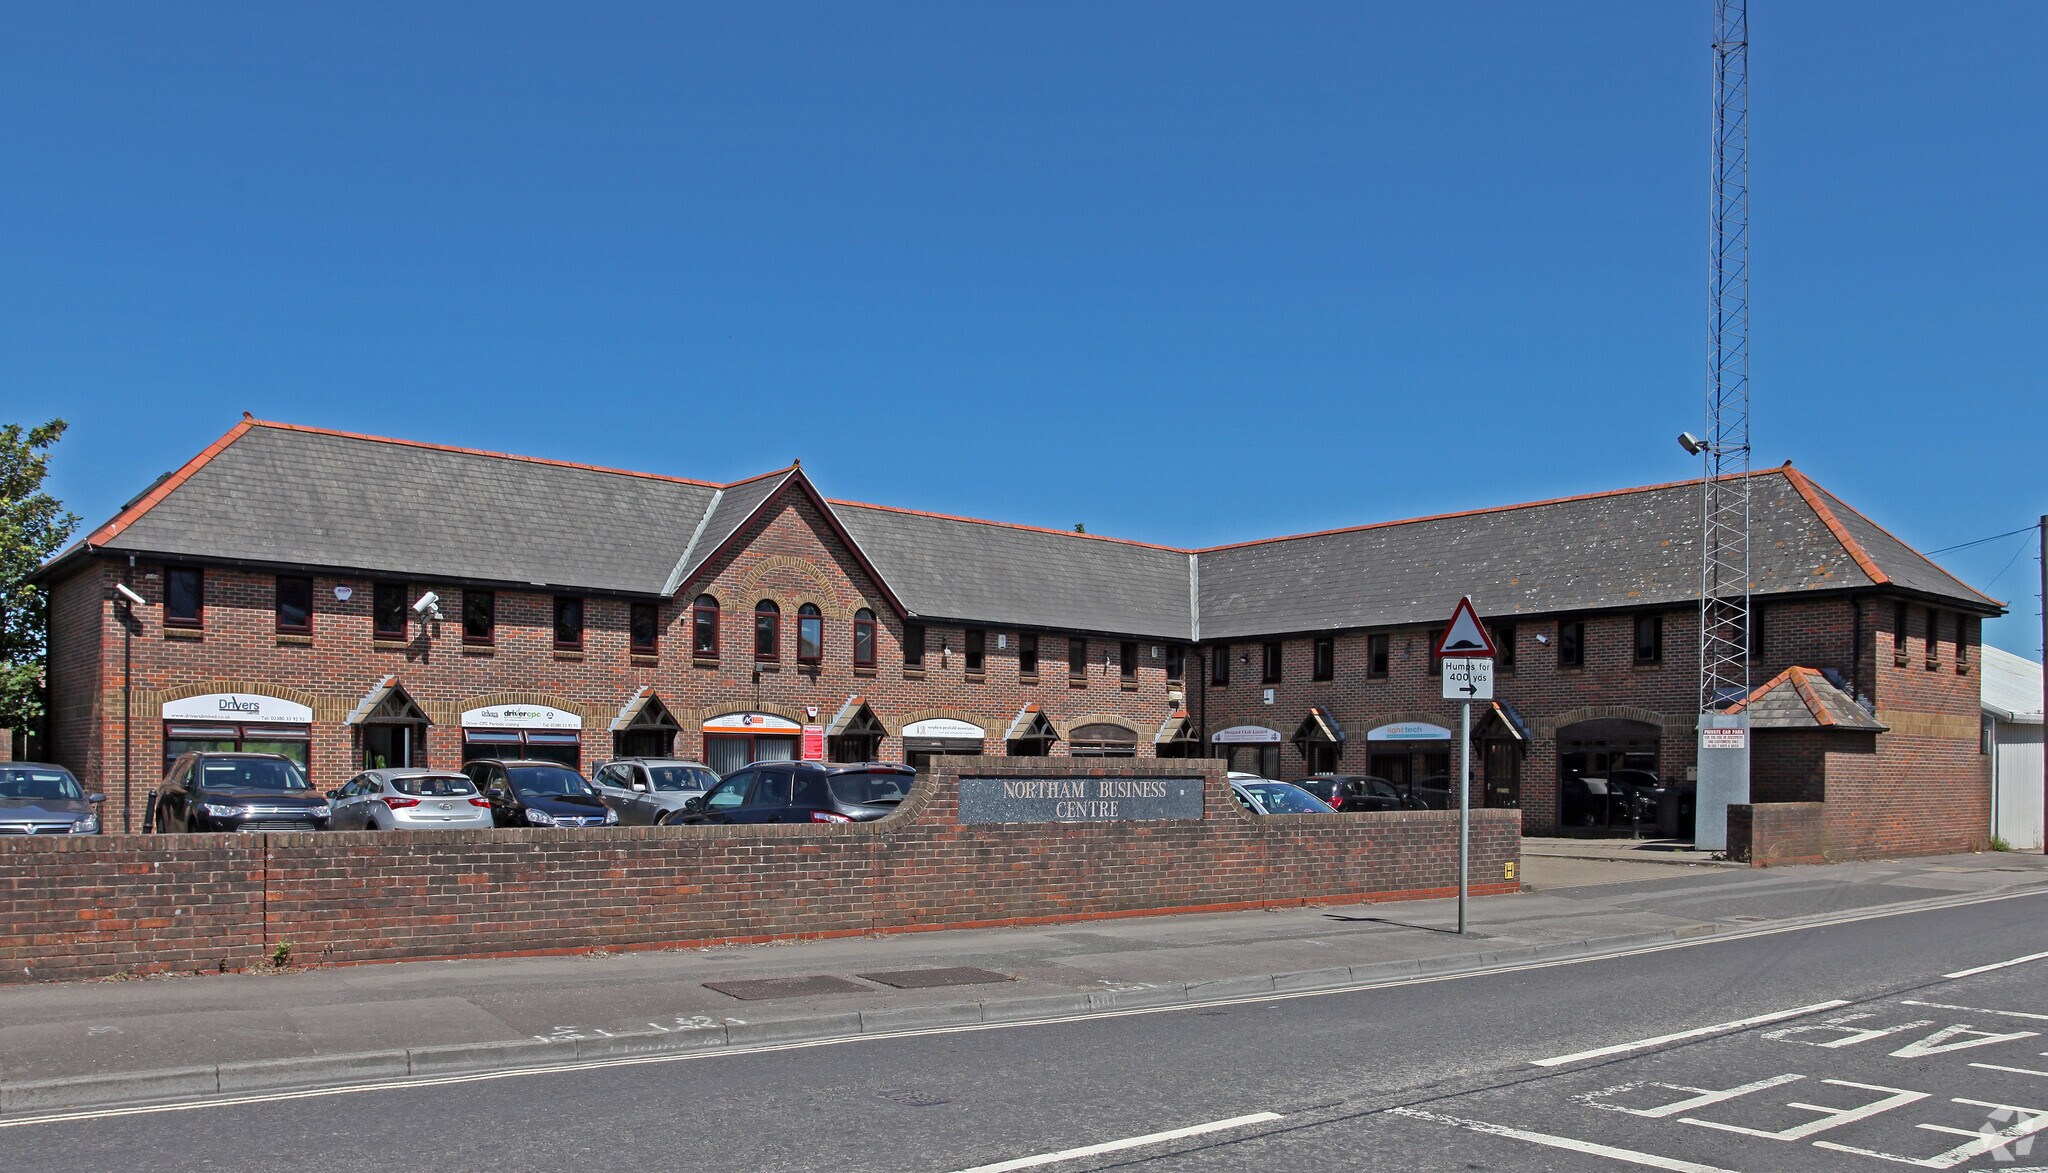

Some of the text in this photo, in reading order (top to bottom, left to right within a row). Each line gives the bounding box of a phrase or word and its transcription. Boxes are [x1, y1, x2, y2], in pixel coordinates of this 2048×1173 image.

[1445, 662, 1475, 671] Humps
[1450, 673, 1486, 682] 400 yds
[219, 697, 260, 711] Drivers
[1003, 781, 1167, 799] NORTHAM BUSINESS
[1056, 800, 1119, 818] CENTRE
